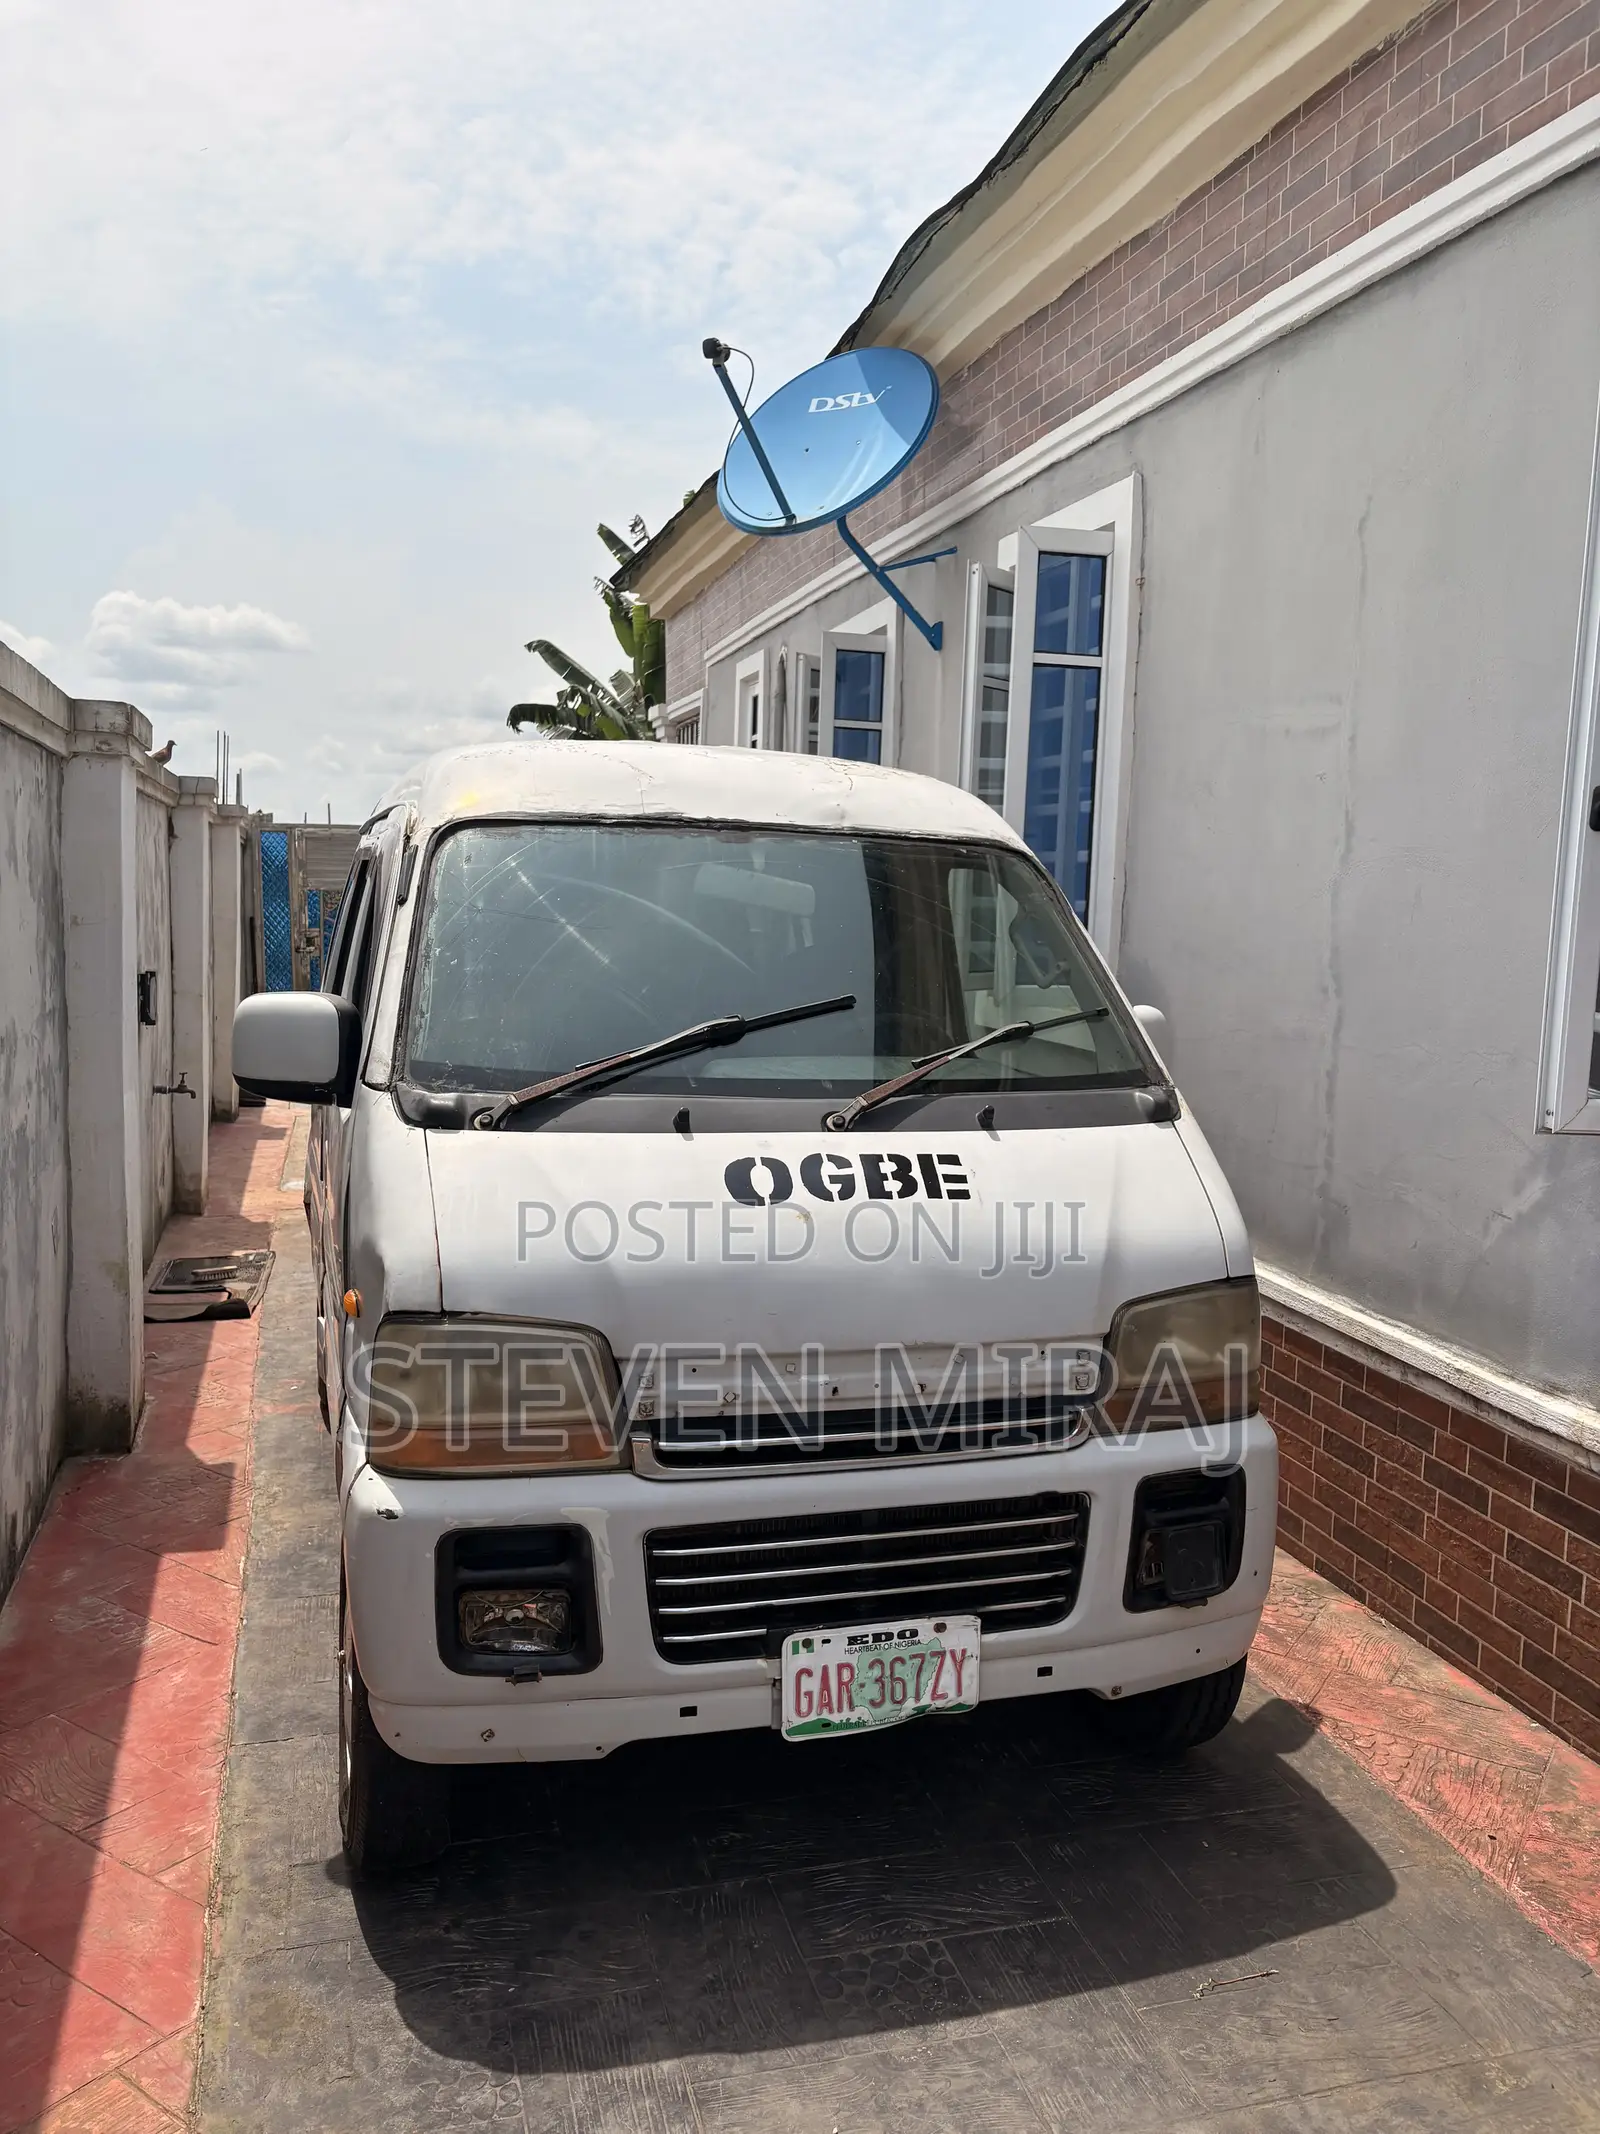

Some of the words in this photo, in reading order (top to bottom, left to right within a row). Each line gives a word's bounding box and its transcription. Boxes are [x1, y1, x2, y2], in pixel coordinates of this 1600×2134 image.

[723, 1153, 971, 1206] OGBE
[846, 1628, 919, 1646] EDO
[844, 1642, 882, 1655] HEARTBEAT
[883, 1641, 894, 1650] OF
[894, 1639, 922, 1650] NIGERIA
